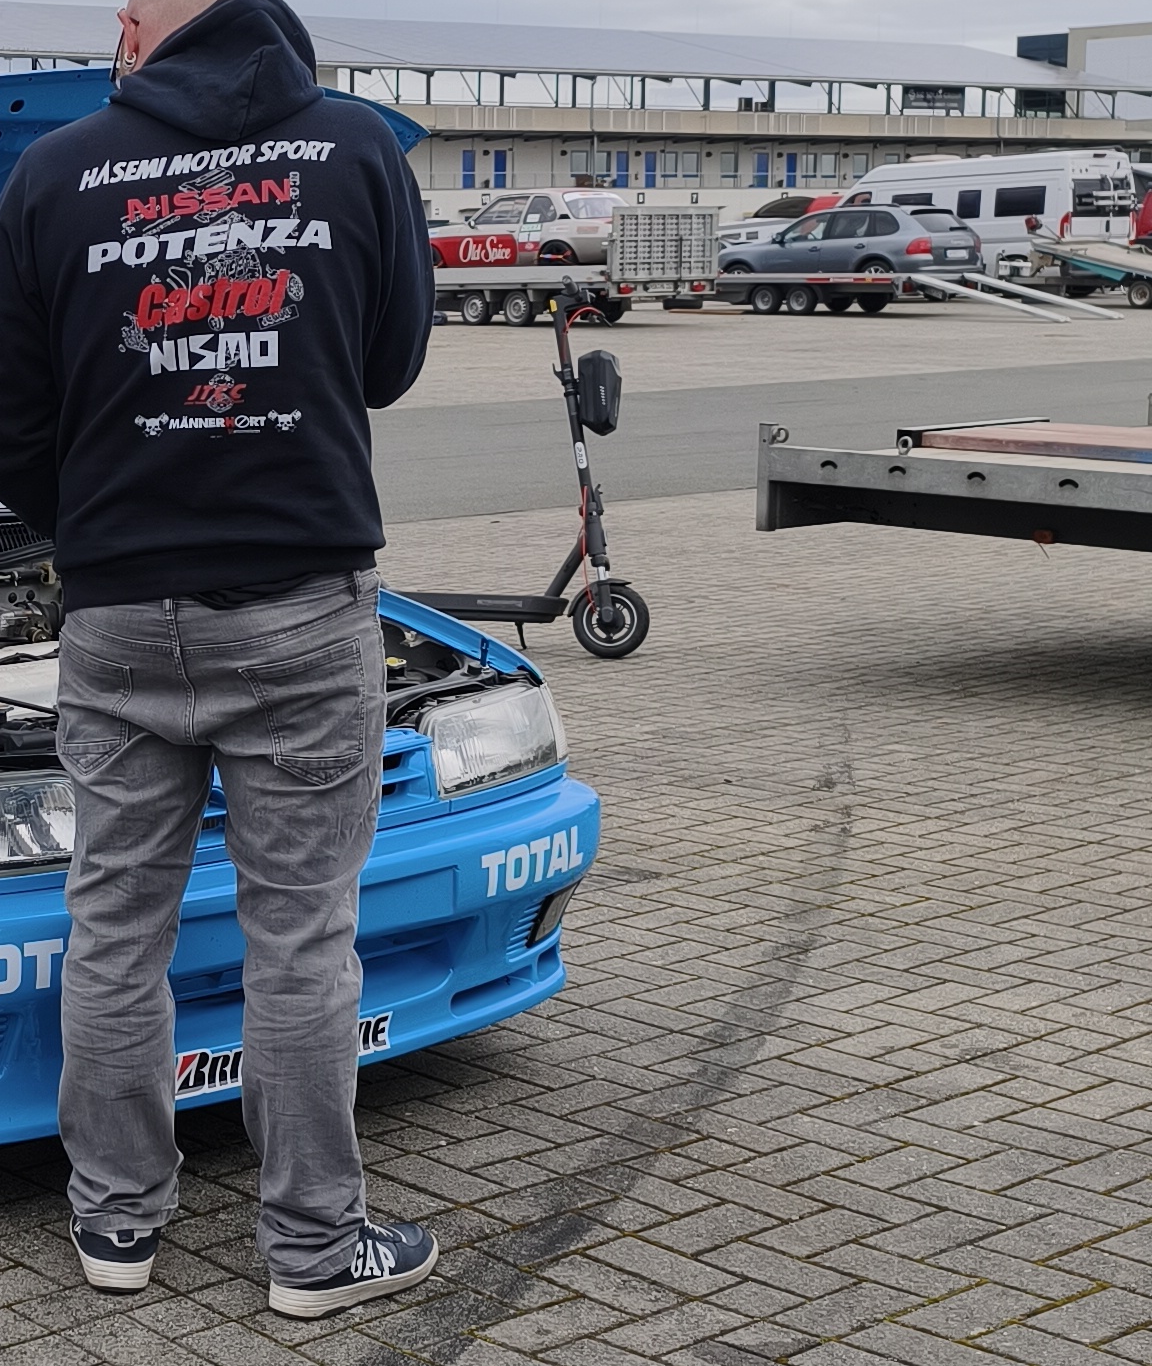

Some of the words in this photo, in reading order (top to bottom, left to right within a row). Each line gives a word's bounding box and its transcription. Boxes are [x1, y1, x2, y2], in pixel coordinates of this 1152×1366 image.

[166, 143, 257, 176] MOTOR
[256, 140, 336, 163] SPORT
[126, 179, 291, 222] NISSAN
[87, 219, 333, 273] POTENZA
[459, 237, 482, 262] Old
[483, 235, 512, 263] Spice
[137, 269, 291, 328] Castrol
[150, 331, 279, 375] NISMO
[481, 825, 584, 898] TOTAL
[350, 1240, 397, 1280] GAP
